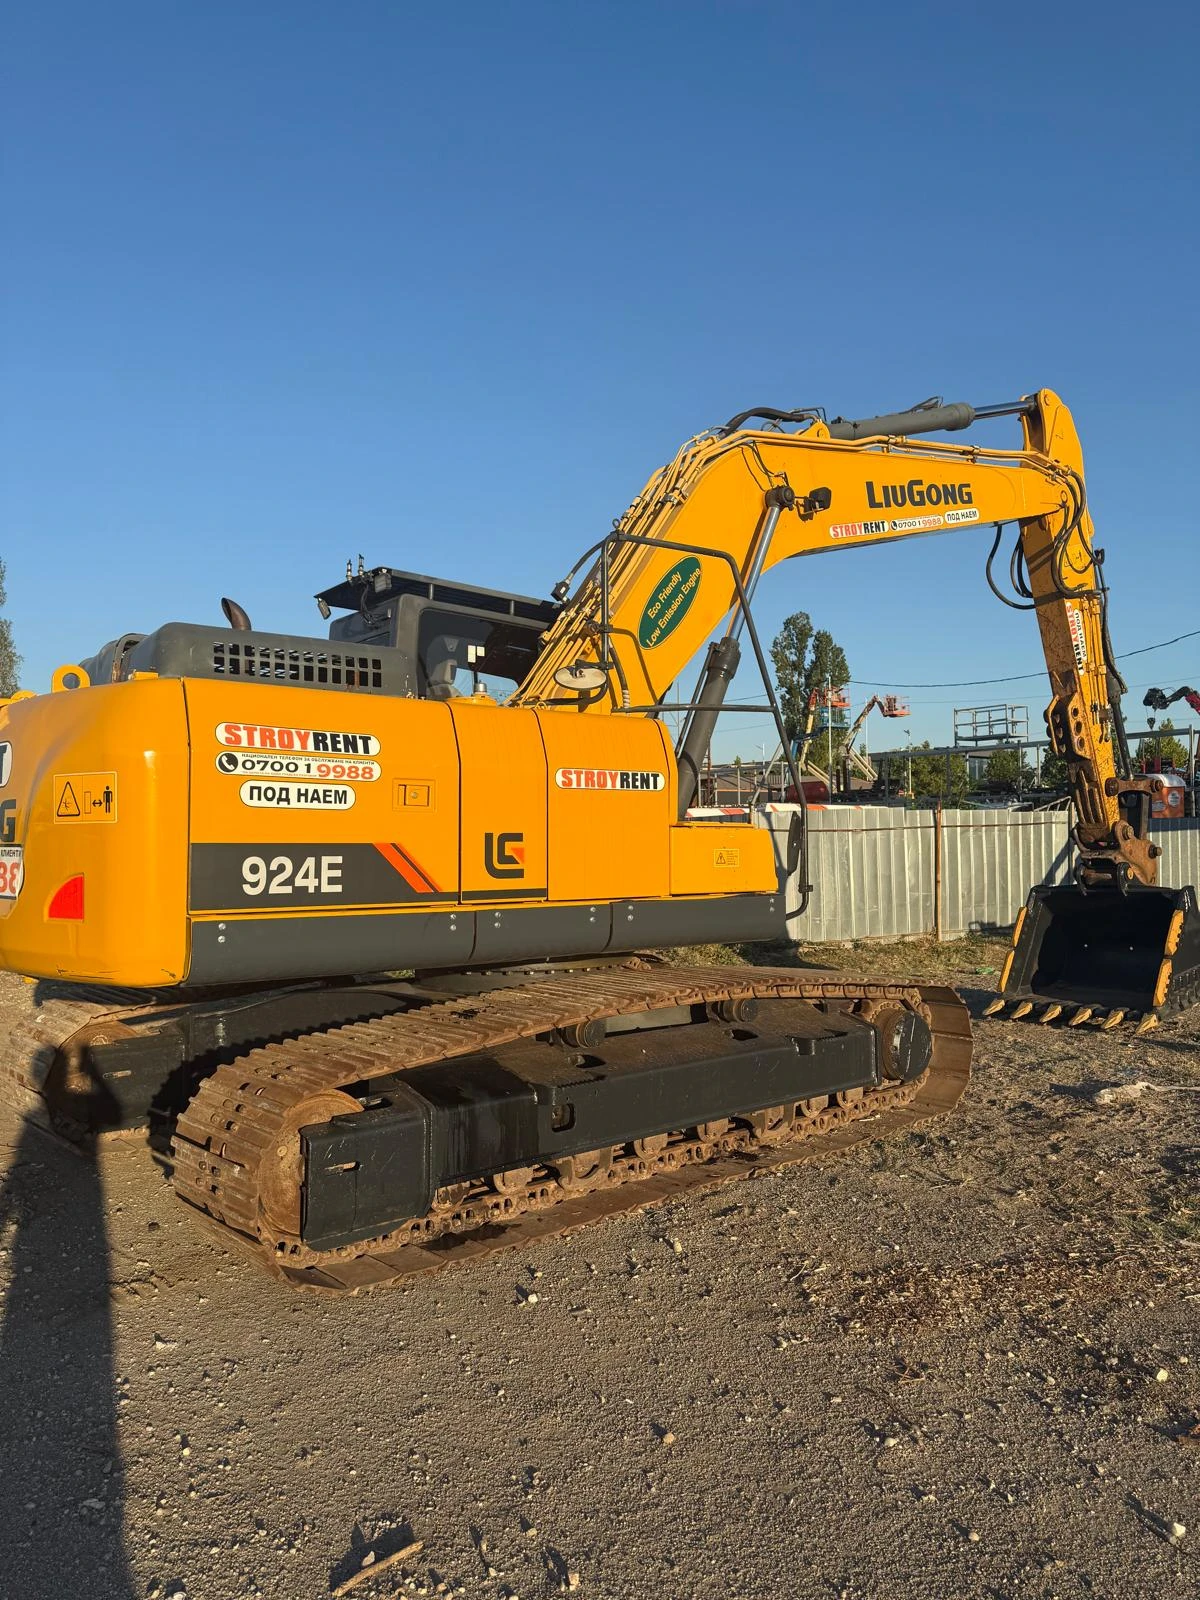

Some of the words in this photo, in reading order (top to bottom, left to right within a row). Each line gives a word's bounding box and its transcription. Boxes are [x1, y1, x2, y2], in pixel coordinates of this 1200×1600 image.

[832, 521, 886, 537] STROYRENT
[946, 512, 960, 522] ПОД
[960, 510, 978, 520] НАЕМ
[647, 627, 661, 646] Low
[658, 593, 684, 629] Emission
[682, 568, 701, 594] Engine
[648, 602, 661, 619] Eco
[658, 571, 682, 603] Friendly
[1066, 605, 1084, 671] STROYRENT
[224, 724, 372, 755] STROYRENT
[317, 763, 374, 779] 9988
[561, 769, 660, 790] STROYRENT
[249, 785, 290, 805] ПОД
[297, 788, 347, 805] НАЕМ
[242, 855, 343, 896] 924E
